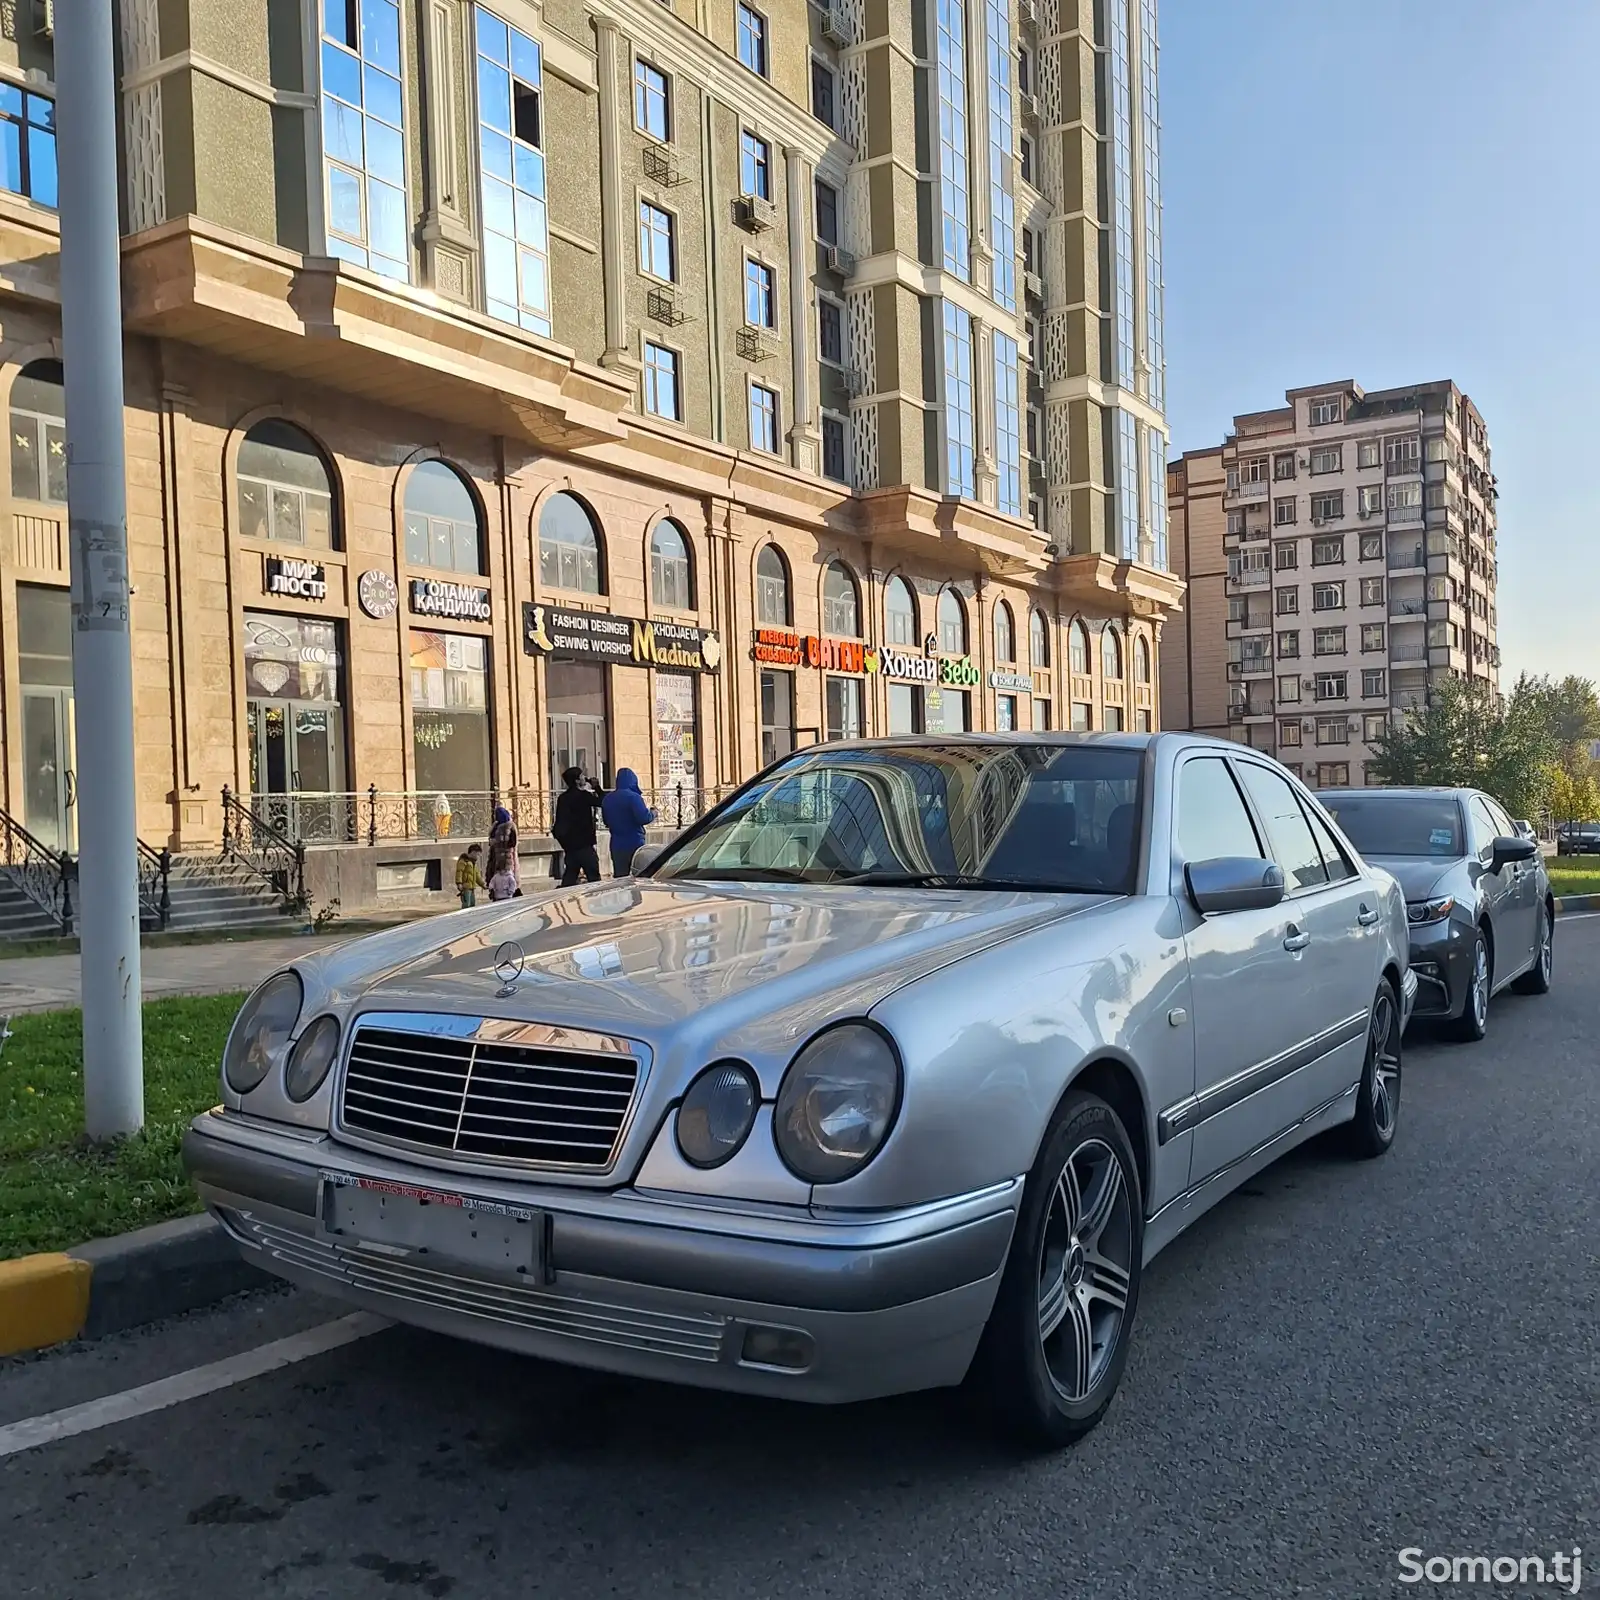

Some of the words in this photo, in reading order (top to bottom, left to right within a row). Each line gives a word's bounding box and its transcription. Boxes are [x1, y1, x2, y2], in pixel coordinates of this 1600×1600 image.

[282, 560, 318, 579] МИР
[270, 575, 328, 597] ЛЮСТР
[364, 571, 394, 590] EURO
[429, 583, 479, 602] ОЛАМИ
[363, 597, 397, 616] LUSTRA
[552, 613, 589, 631] FASHION
[590, 619, 629, 636] DESINGER
[654, 623, 699, 641] KHODJAEVA
[553, 634, 589, 650] SEWING
[591, 639, 632, 656] WORSHOP
[633, 619, 701, 668] Madina
[807, 636, 864, 673] ВАТАН
[940, 656, 980, 685] Зебо
[366, 1180, 419, 1198] Mercedes-Benz
[472, 1200, 504, 1215] Mercedes
[506, 1206, 522, 1217] Benz
